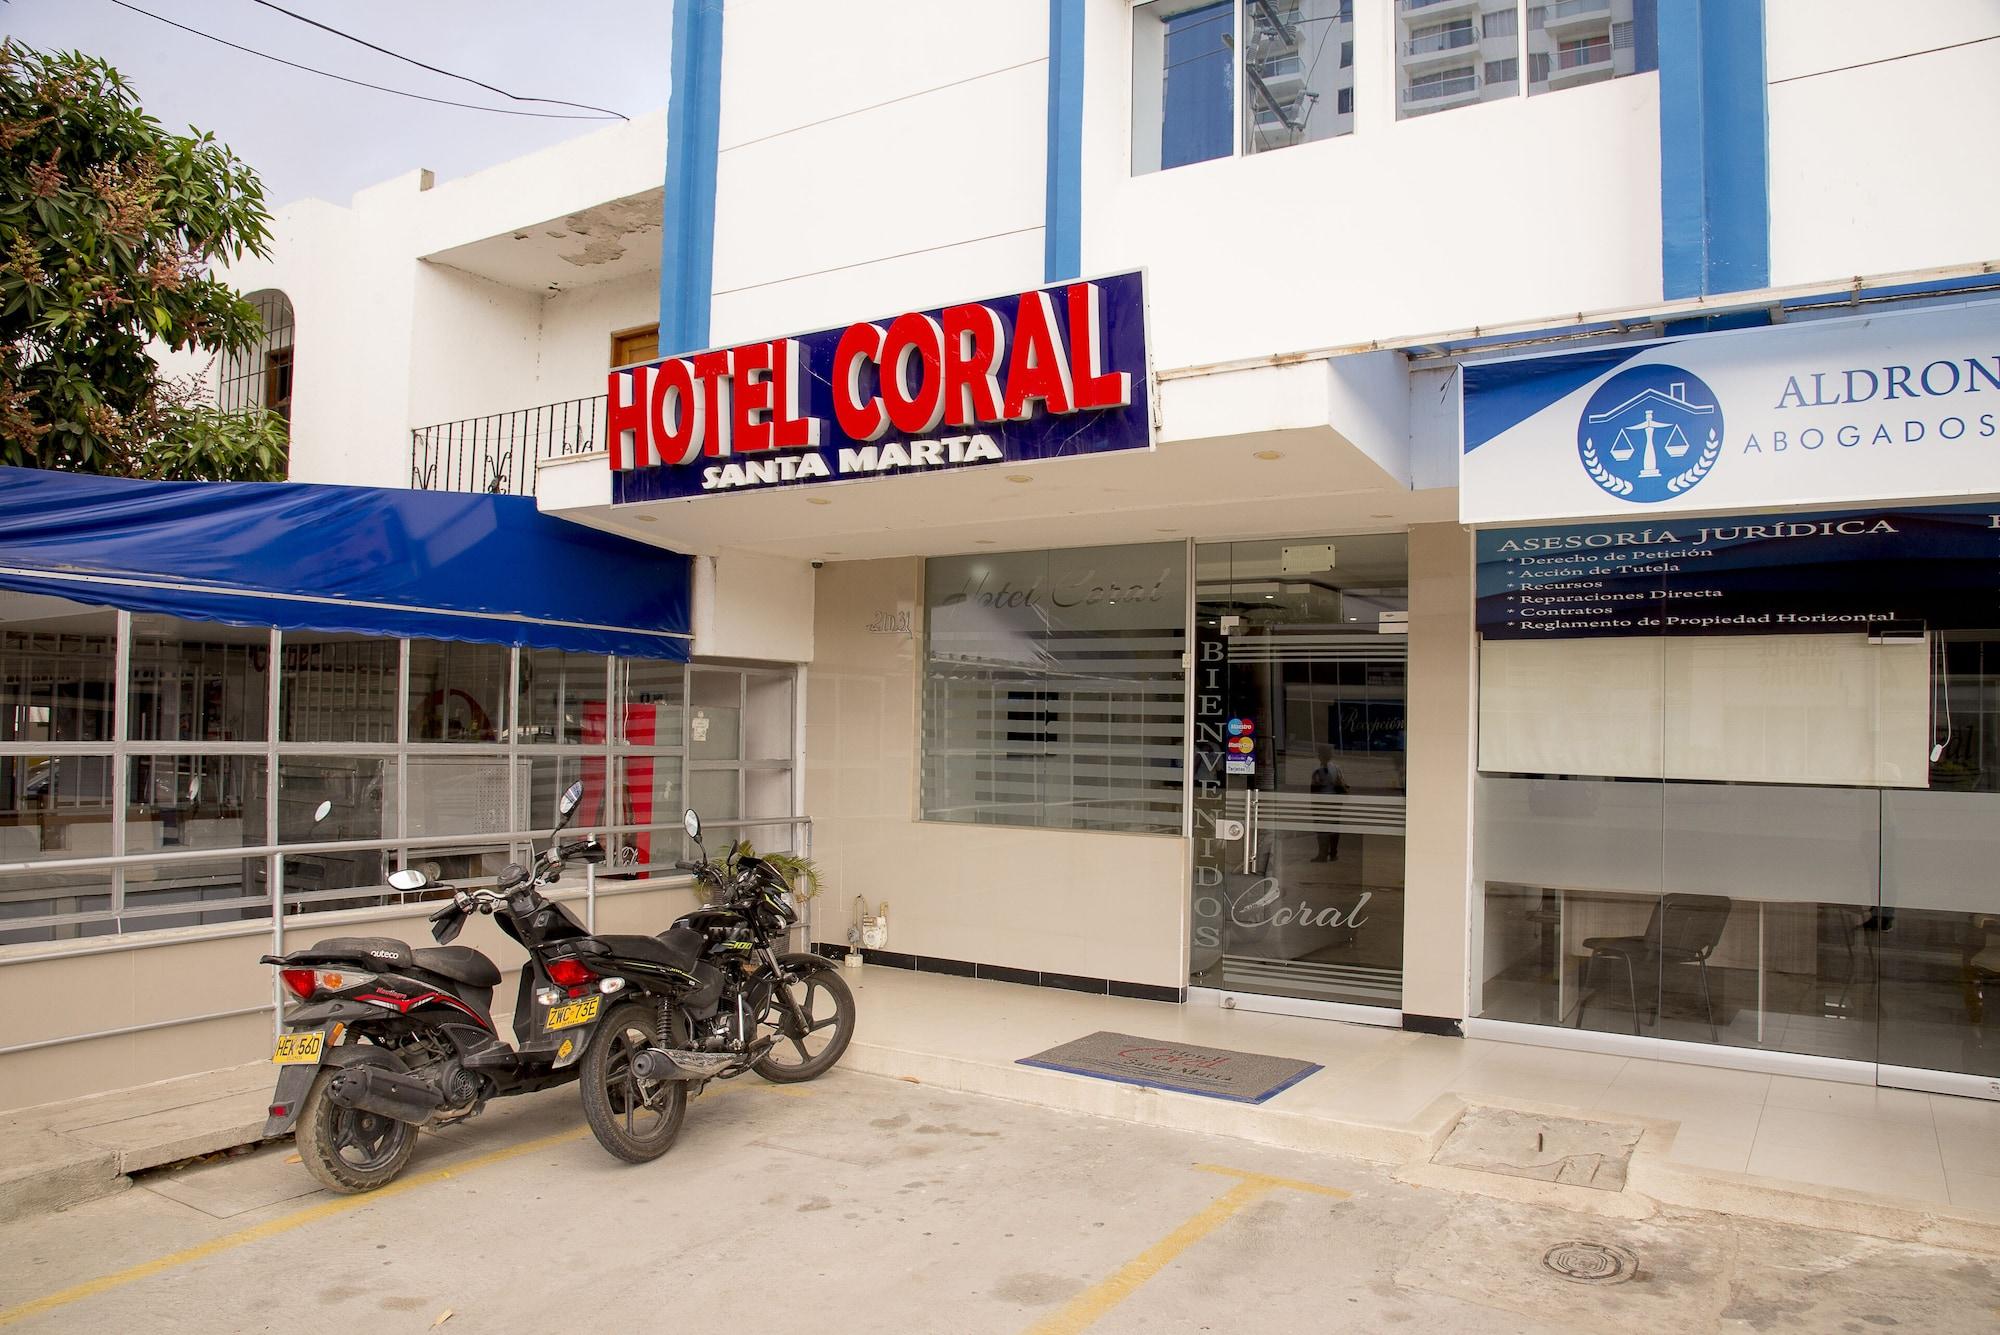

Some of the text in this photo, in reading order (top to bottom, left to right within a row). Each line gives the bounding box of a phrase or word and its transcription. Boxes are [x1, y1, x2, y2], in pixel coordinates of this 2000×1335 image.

[608, 282, 1132, 472] HOTEL CORAL
[1774, 355, 2000, 409] ALDRON
[1743, 414, 1996, 455] ABOGADOS
[702, 434, 1004, 490] SANTA MARTA
[1499, 519, 1899, 552] ASESORÍA JURÍDICA
[1519, 547, 1714, 566] Derecho de Petición
[1519, 562, 1681, 579] Acción de Tutela
[943, 567, 1172, 609] Hotel Coral
[1520, 580, 1604, 592] Recursos
[1520, 588, 1724, 606] Reparaciones Directa
[1519, 606, 1614, 618] Contratos
[1520, 611, 1897, 632] Reglamento de Propiedad Horizontal
[1193, 640, 1226, 948] BIENVENIDOS
[1231, 877, 1371, 930] Coral
[733, 941, 754, 950] 100
[548, 1001, 597, 1026] ZWC 73E
[275, 1037, 320, 1057] HEK 56D
